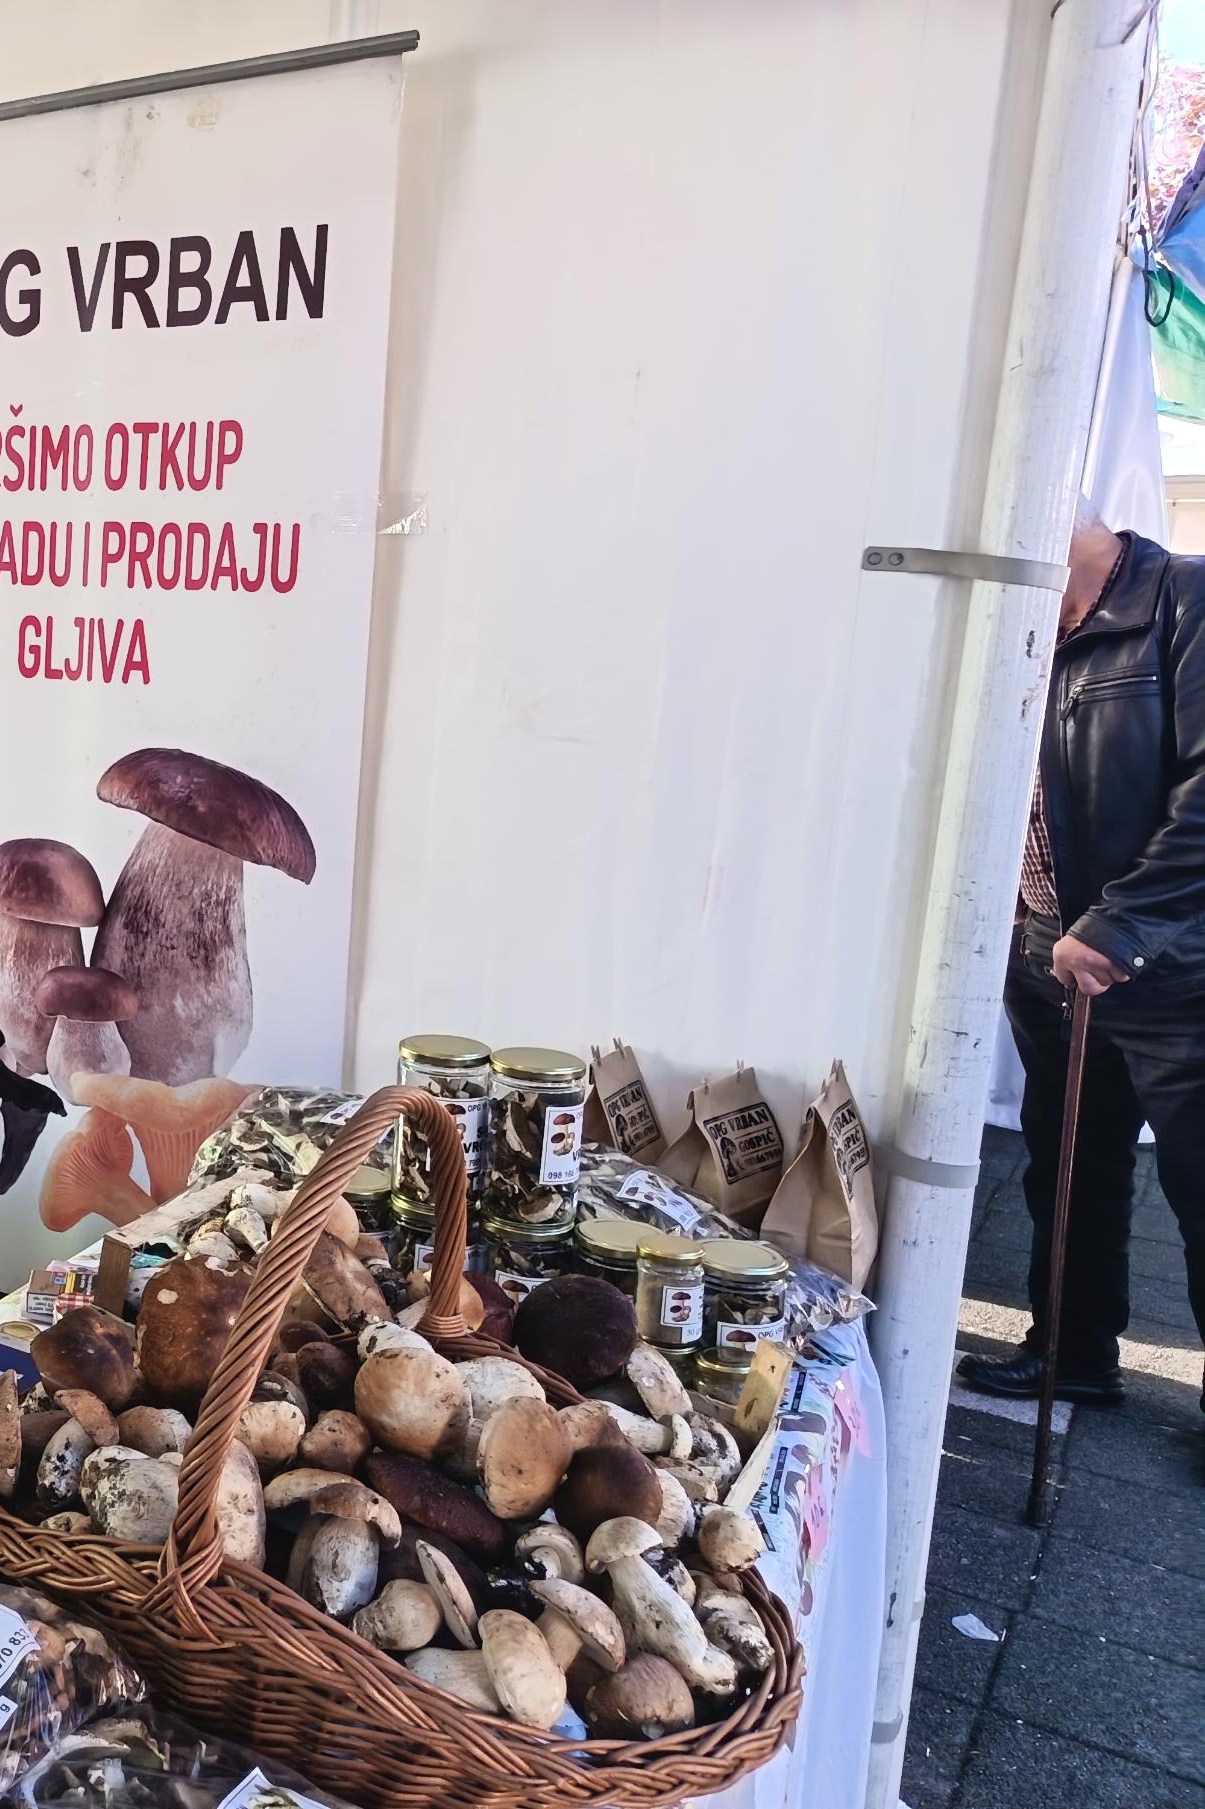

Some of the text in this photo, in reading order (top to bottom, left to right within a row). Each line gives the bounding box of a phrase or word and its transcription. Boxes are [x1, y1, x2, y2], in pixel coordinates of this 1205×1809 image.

[66, 224, 329, 333] VRBAN
[104, 420, 243, 491] OTKUP
[82, 522, 90, 587] I
[100, 521, 301, 593] PRODAJU
[17, 615, 151, 685] GLJIVA
[709, 1108, 769, 1140] OPG VRBAN
[548, 1170, 562, 1179] 098
[0, 1703, 11, 1715] g
